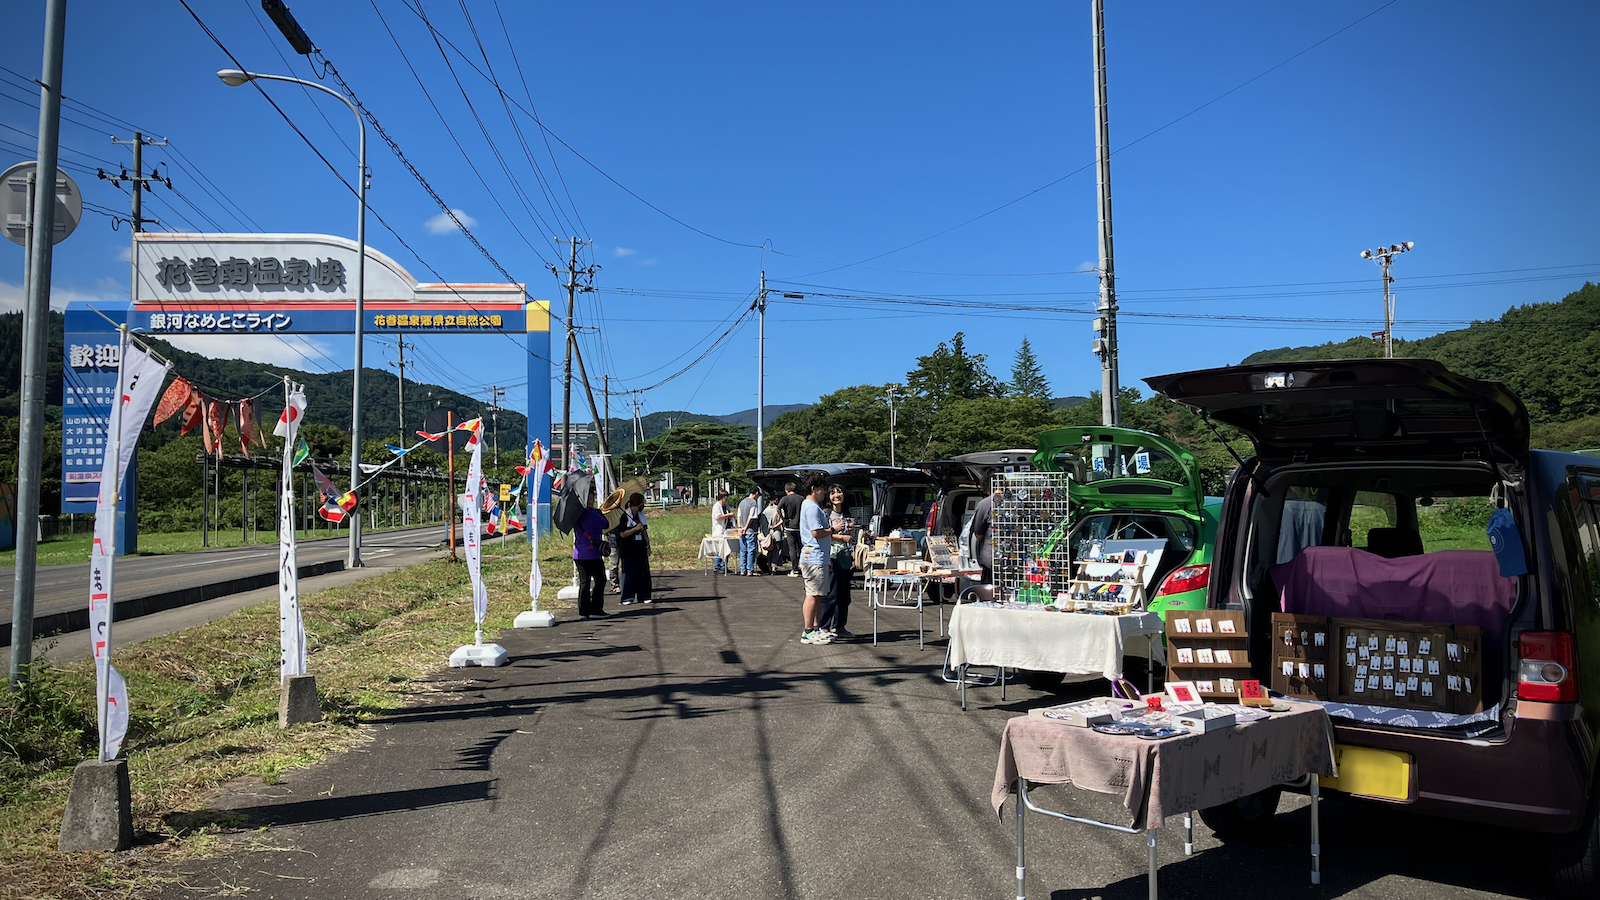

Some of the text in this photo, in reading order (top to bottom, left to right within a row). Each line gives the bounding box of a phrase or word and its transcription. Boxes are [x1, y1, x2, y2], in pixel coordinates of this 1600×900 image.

[155, 256, 342, 287] 花巻南温泉峡
[150, 312, 291, 330] 銀河なめとこライン
[374, 314, 502, 327] 花巻温泉郷県立自然公園
[69, 344, 120, 368] 歓迎
[66, 417, 103, 425] 山の神温泉
[66, 427, 103, 435] 大沢温泉
